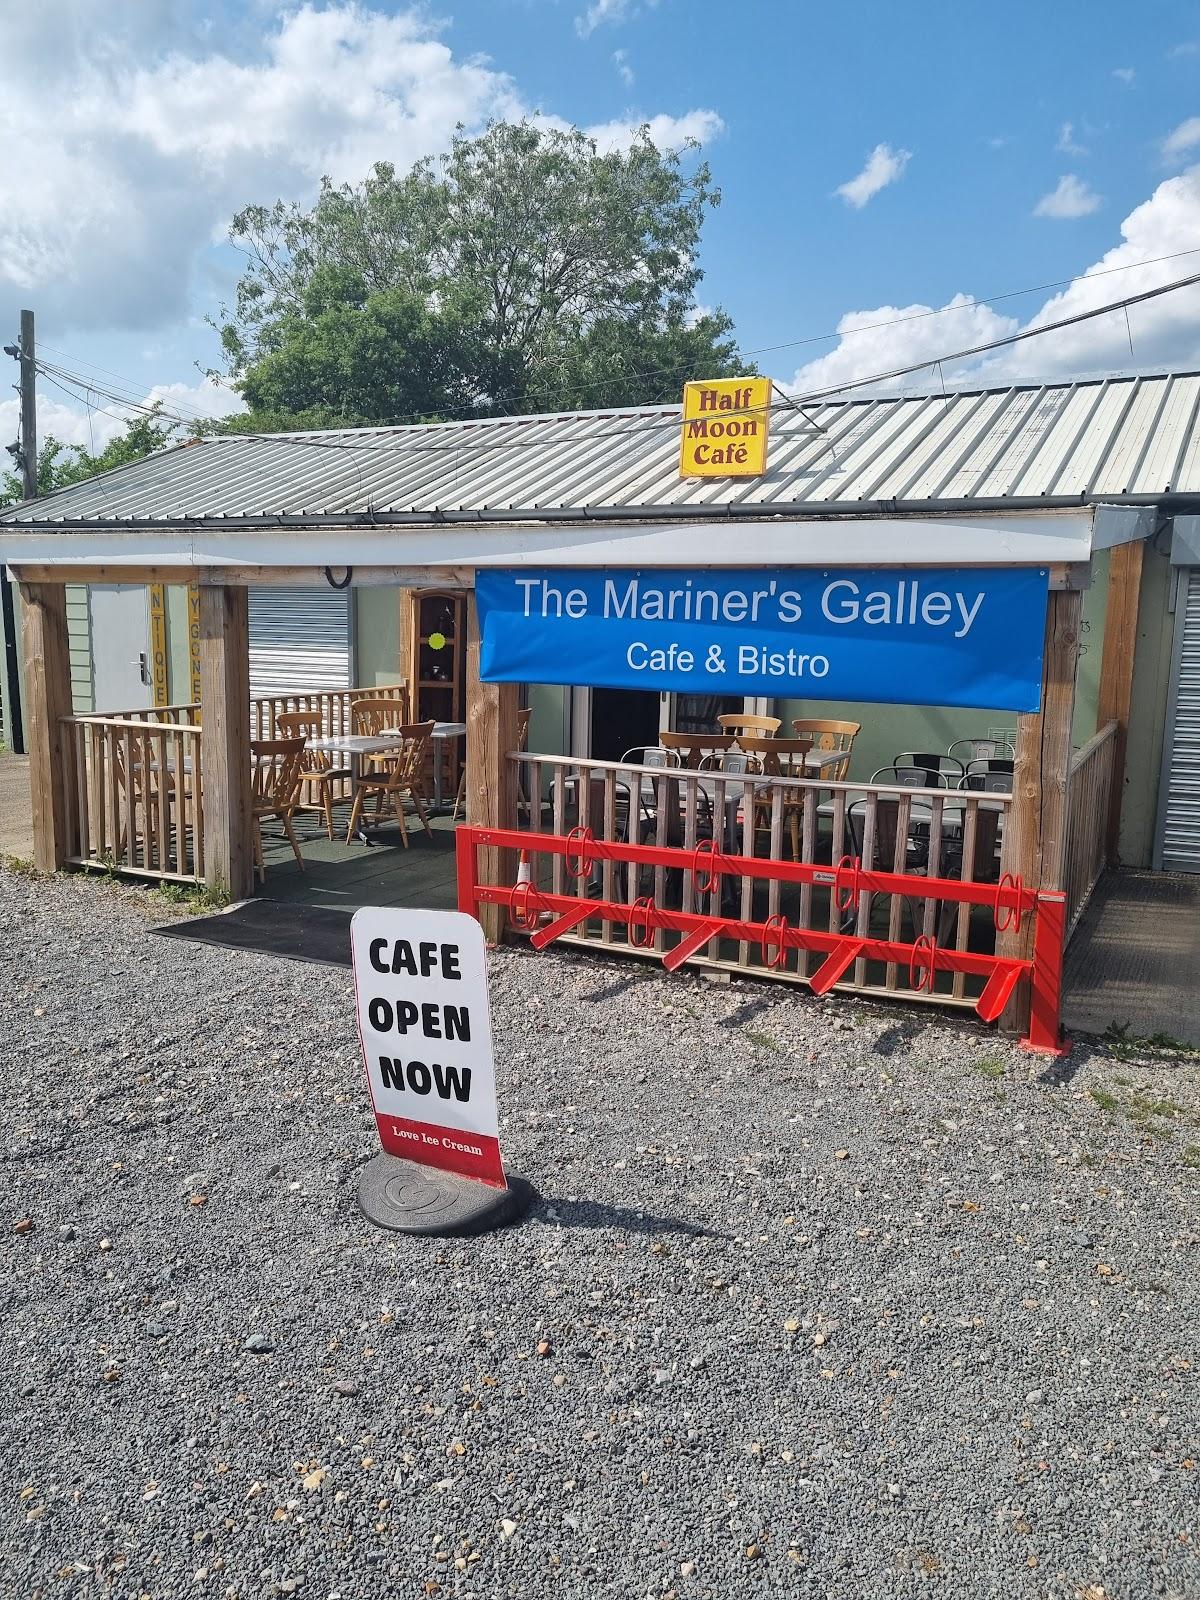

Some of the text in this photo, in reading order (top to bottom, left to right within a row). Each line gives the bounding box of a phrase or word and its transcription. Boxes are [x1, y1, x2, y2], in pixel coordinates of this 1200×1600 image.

[699, 388, 754, 411] Half
[687, 418, 758, 439] Moon
[693, 442, 748, 465] Café
[515, 579, 985, 638] The Mariner's Galley
[152, 583, 164, 702] NTIQUE
[626, 642, 830, 678] Cafe & Bistro
[369, 938, 462, 981] CAFE
[368, 997, 471, 1042] OPEN
[378, 1056, 472, 1102] NOW
[392, 1125, 483, 1156] Love Ice Cream
